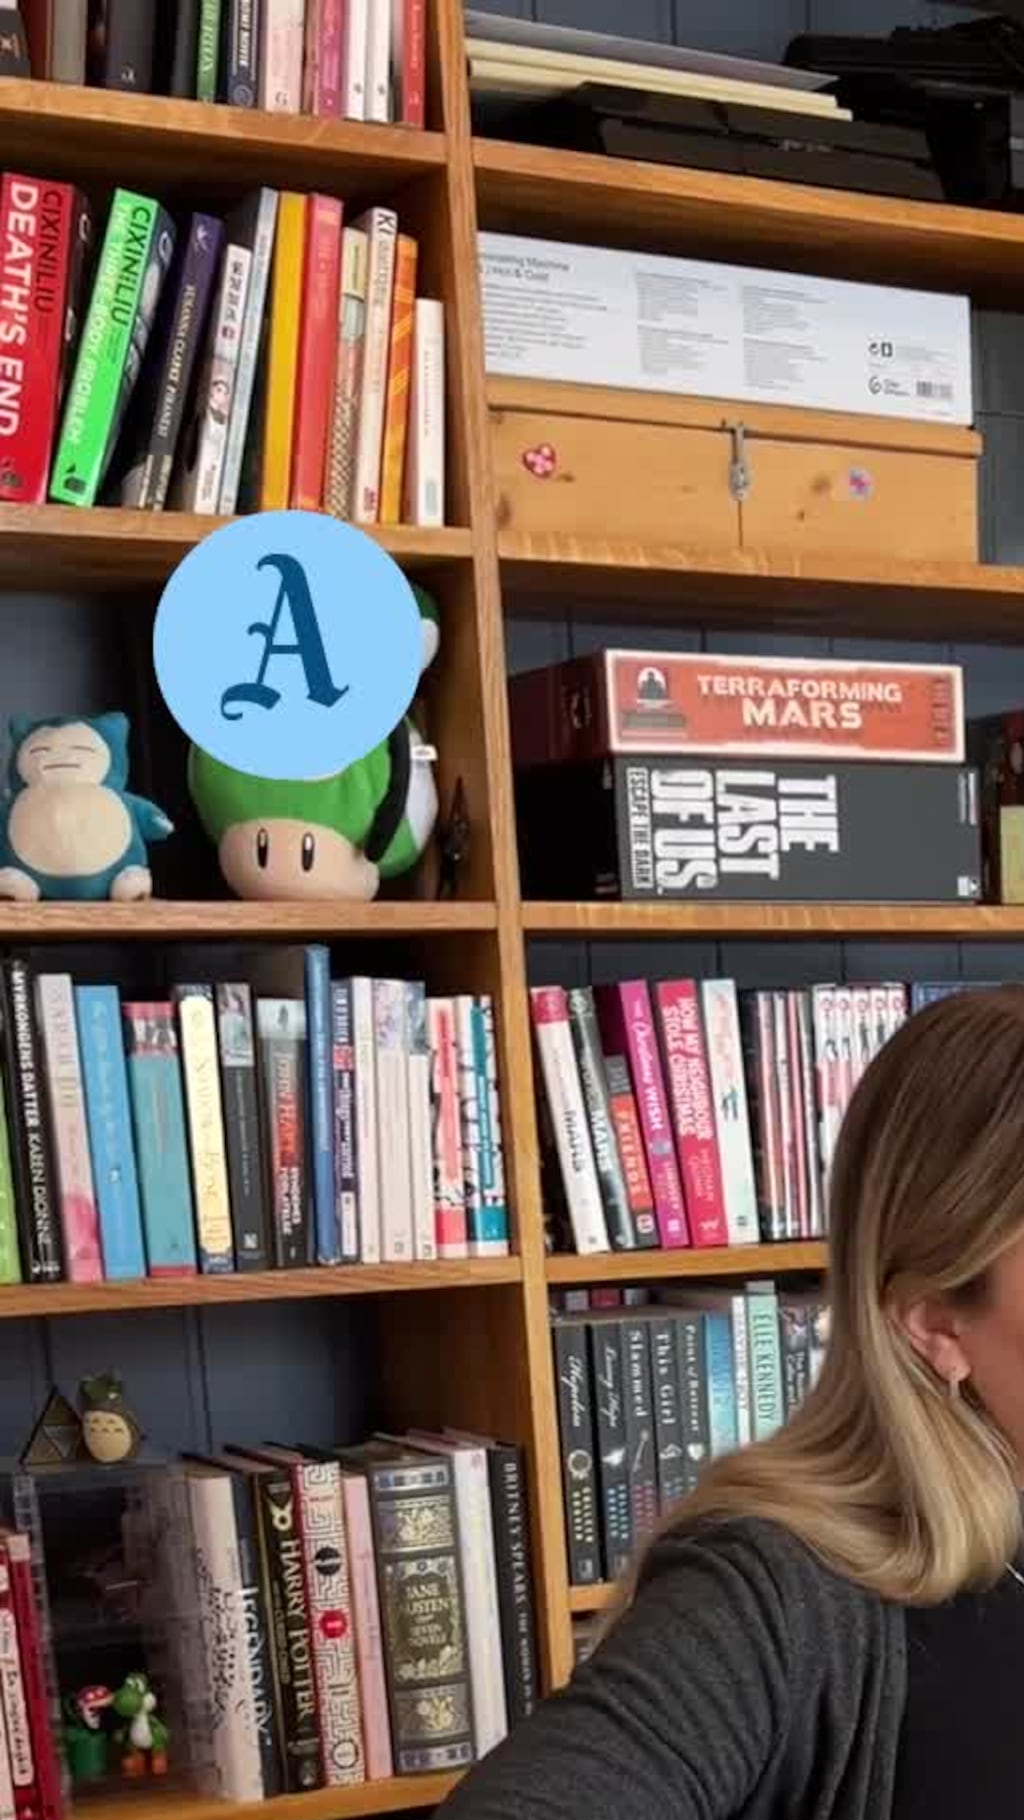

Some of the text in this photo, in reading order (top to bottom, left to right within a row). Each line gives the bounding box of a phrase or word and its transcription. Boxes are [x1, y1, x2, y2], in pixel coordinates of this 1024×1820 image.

[0, 182, 38, 436] DEATH'S END
[66, 357, 98, 445] PROBLEM
[697, 673, 903, 703] TERRAFORMING
[741, 700, 863, 729] MARS
[651, 768, 715, 823] OF
[714, 769, 780, 880] LAST
[777, 774, 839, 852] THE
[653, 827, 719, 893] US
[12, 968, 51, 1245] MYRKONGENS DATTER KAREN DIONNE
[645, 1085, 663, 1131] WISH
[662, 1006, 698, 1137] STOLE CHRISTMAS
[678, 997, 714, 1140] HOW MY NEIGHBOUR
[590, 1110, 615, 1173] MARS
[619, 1112, 646, 1196] FRIENDS
[627, 1329, 649, 1418] Slammed
[655, 1333, 677, 1425] This Girl
[753, 1313, 778, 1422] ELLE KENNEDY
[503, 1463, 524, 1534] BRITNEY
[404, 1598, 449, 1614] USTEN
[510, 1542, 528, 1604] SPEARS
[279, 1539, 317, 1717] HARRY POTTER
